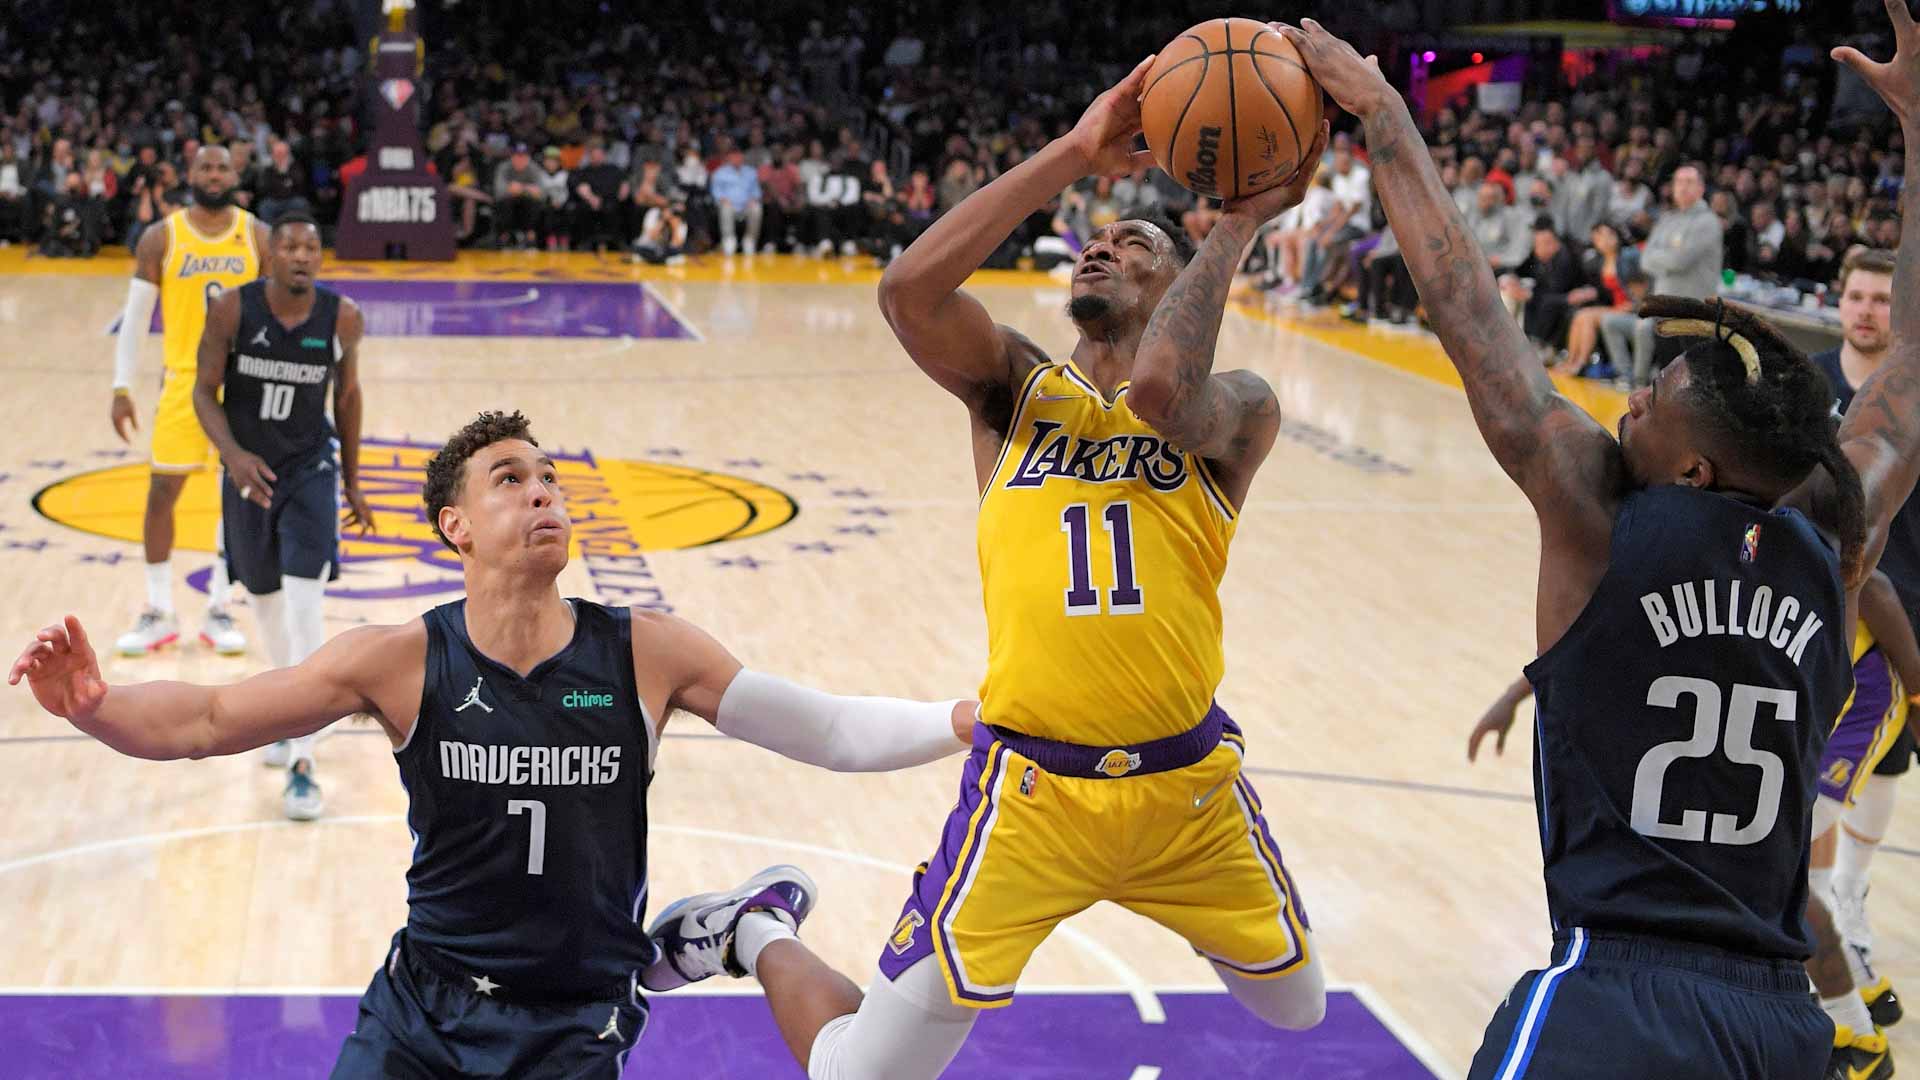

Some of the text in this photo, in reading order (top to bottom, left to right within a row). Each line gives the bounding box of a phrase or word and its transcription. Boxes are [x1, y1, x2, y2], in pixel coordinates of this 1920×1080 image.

[1186, 127, 1222, 193] ilson
[179, 254, 246, 278] LAKERS
[238, 354, 327, 384] MAVERICKS
[260, 383, 295, 420] 10
[1004, 418, 1187, 492] LAKERS
[1060, 501, 1145, 616] 11
[1640, 579, 1823, 666] BULLOCK
[562, 690, 614, 707] chime
[439, 740, 622, 785] MAVERICKS
[1630, 675, 1798, 846] 25
[507, 799, 546, 875] 7
